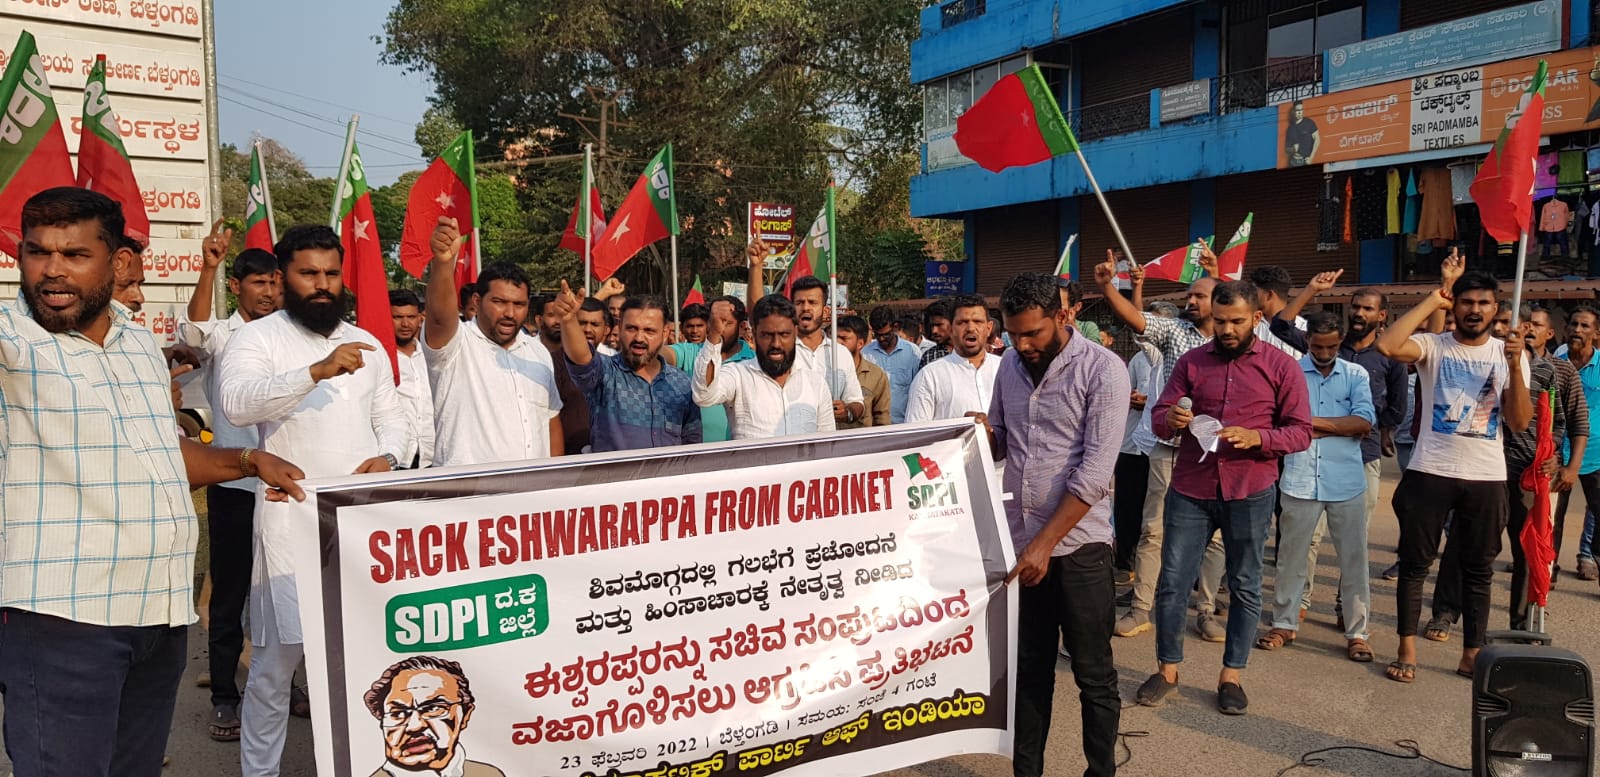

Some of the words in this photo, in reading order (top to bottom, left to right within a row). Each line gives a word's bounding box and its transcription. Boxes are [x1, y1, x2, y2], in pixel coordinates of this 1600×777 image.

[130, 1, 199, 27] ಬೆಳ್ತಂಗಡಿ
[147, 59, 201, 90] ಬೆಳ್ತಂಗಡಿ
[1508, 69, 1578, 93] DOLAR
[1411, 123, 1426, 136] SRI
[1428, 115, 1479, 133] PADMAMBA
[1424, 134, 1465, 151] TEXTILES
[141, 187, 201, 213] ಳ್ತಂಗಡಿ
[369, 521, 470, 583] SACK
[478, 494, 698, 568] ESHWARAPPA
[704, 483, 781, 534] FROM
[787, 469, 894, 522] CABINET
[588, 561, 717, 600] ಶಿವಮೊಗ್ಗದಲ್ಲಿ
[728, 547, 795, 577] ಗಲಭೆಗೆ
[805, 532, 897, 570] ಪ್ರಚೋದನೆ
[494, 583, 537, 609] ದ.ಕ
[575, 604, 632, 635] ಮತ್ತು
[645, 580, 770, 621] ಹಿಂಸಾಚಾರಕ್ಕೆ
[780, 568, 845, 601] ನೇತೃತ್ವ
[855, 559, 914, 588] ನೀಡಿದ
[394, 594, 489, 646] SDPI
[498, 608, 537, 637] ಜಿಲ್ಲೆ
[524, 635, 707, 708] ಈಶ್ವರಪ್ಪರನ್ನು
[709, 617, 787, 662] ಸಚಿವ
[511, 683, 736, 745] ವಜಾಗೊಳಿಸಲು
[857, 625, 974, 691] ಪ್ರತಿಭಟನೆ
[560, 755, 581, 769] 23
[591, 747, 648, 768] ಫೆಬ್ರವರಿ
[656, 737, 697, 757] 2022
[719, 720, 779, 747] ಬೆಳ್ತಂಗಡಿ
[797, 704, 850, 727] ಸಮಯ:
[891, 685, 899, 696] 4
[906, 672, 937, 692] ಗಂಟೆ
[738, 737, 810, 771] ಪಾರ್ಟಿ
[821, 710, 869, 746] ಆಫ್
[882, 692, 985, 731] ಇಂಡಿಯಾ
